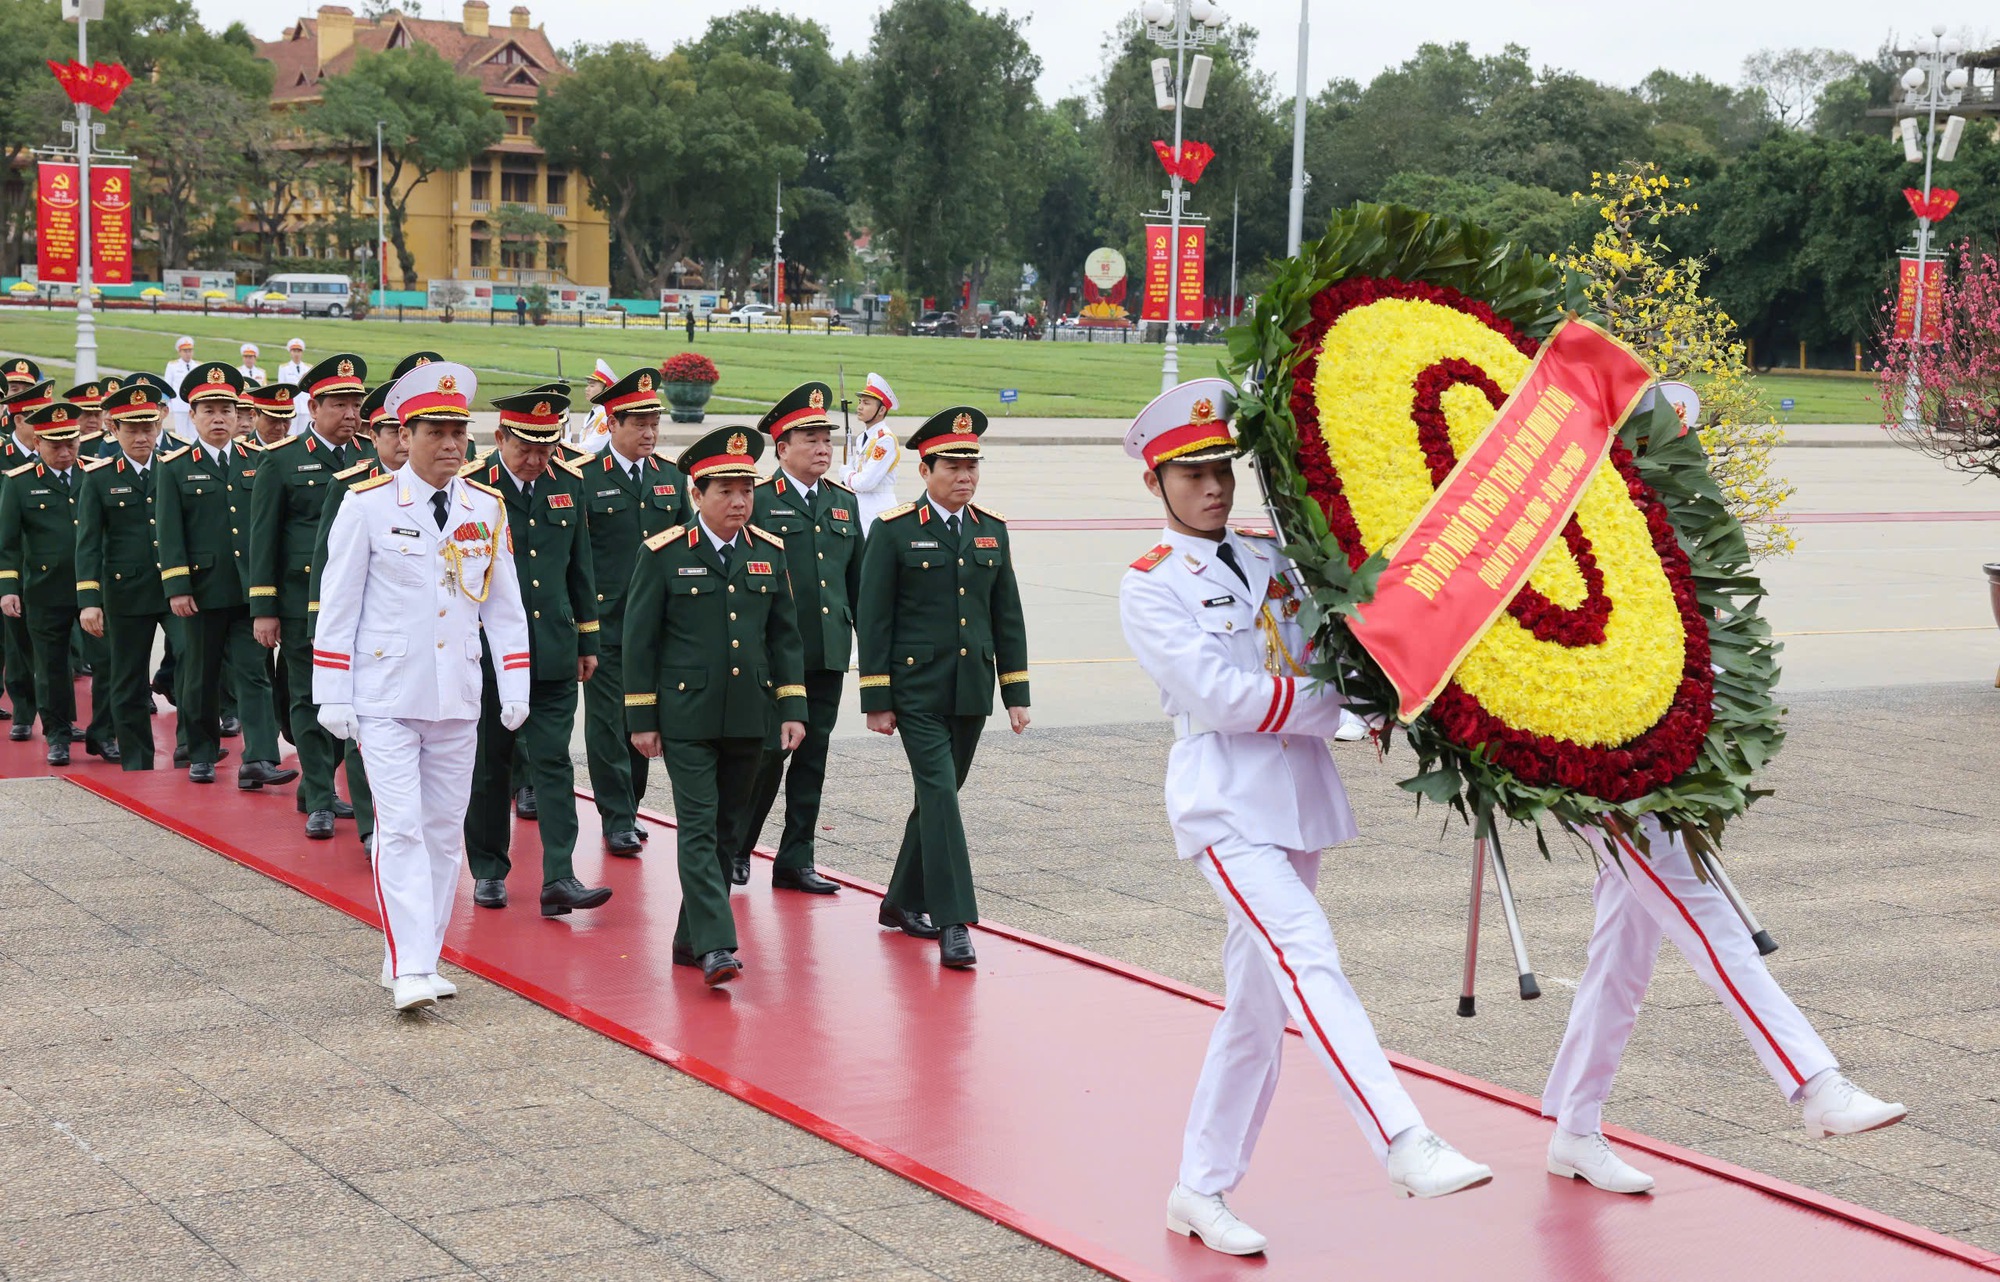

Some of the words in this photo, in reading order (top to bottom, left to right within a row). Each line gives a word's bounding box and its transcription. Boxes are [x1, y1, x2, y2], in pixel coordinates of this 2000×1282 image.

[1514, 420, 1546, 460] CHÍ
[1524, 404, 1561, 446] MINH
[1501, 434, 1535, 474] HỒ
[1469, 471, 1509, 516] CHỦ
[1488, 455, 1528, 496] TỊCH
[1438, 513, 1480, 559] NHỚ
[1458, 501, 1494, 533] ƠN
[1420, 541, 1461, 579] ĐỜI
[1478, 551, 1511, 590] QUÂN
[1504, 516, 1539, 554] TRUNG
[1403, 563, 1445, 600] ĐỜI
